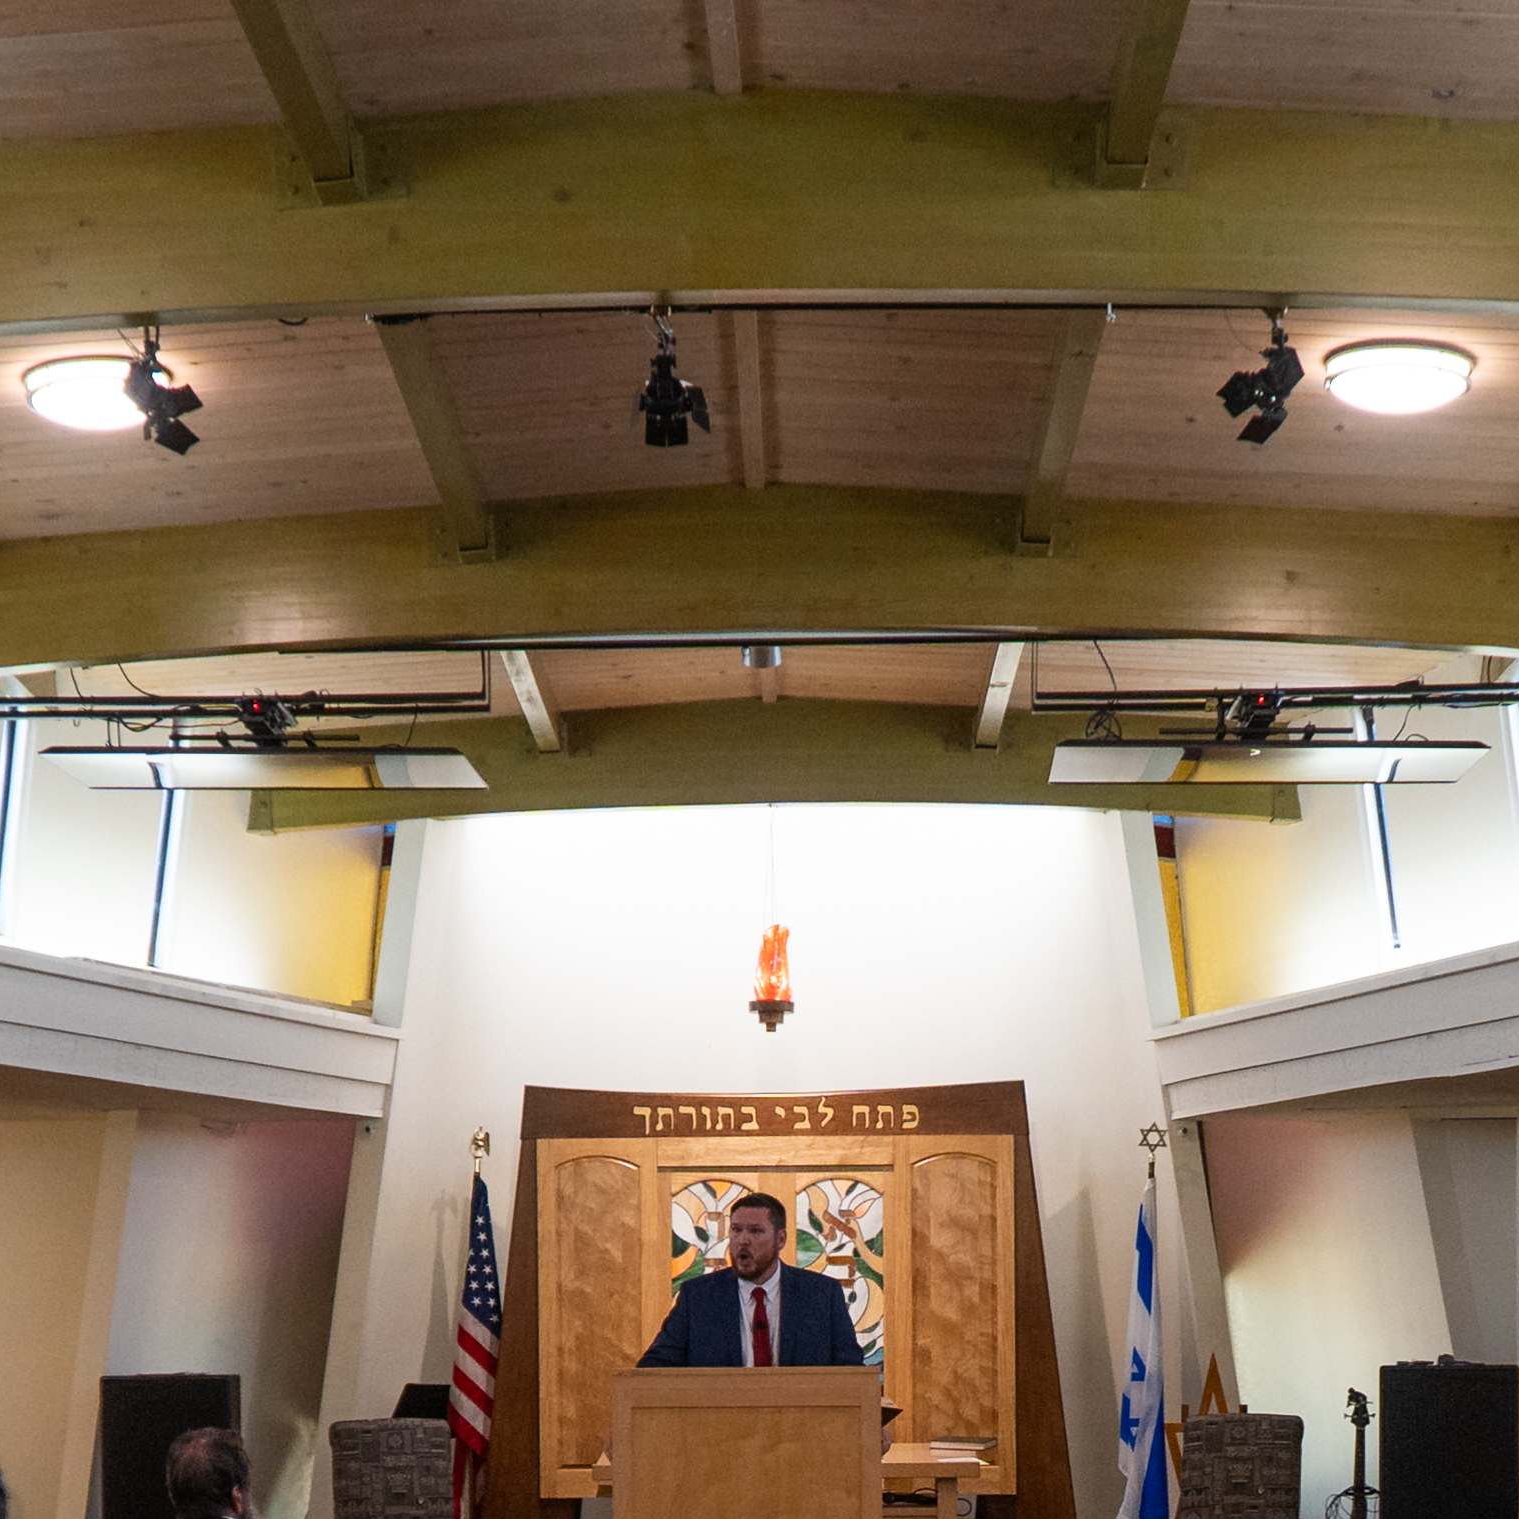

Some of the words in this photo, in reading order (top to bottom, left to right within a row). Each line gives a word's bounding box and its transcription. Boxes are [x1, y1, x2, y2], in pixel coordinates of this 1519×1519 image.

[633, 1106, 759, 1135] בתורתך
[775, 1096, 834, 1129] לבי
[852, 1104, 919, 1129] פתח
